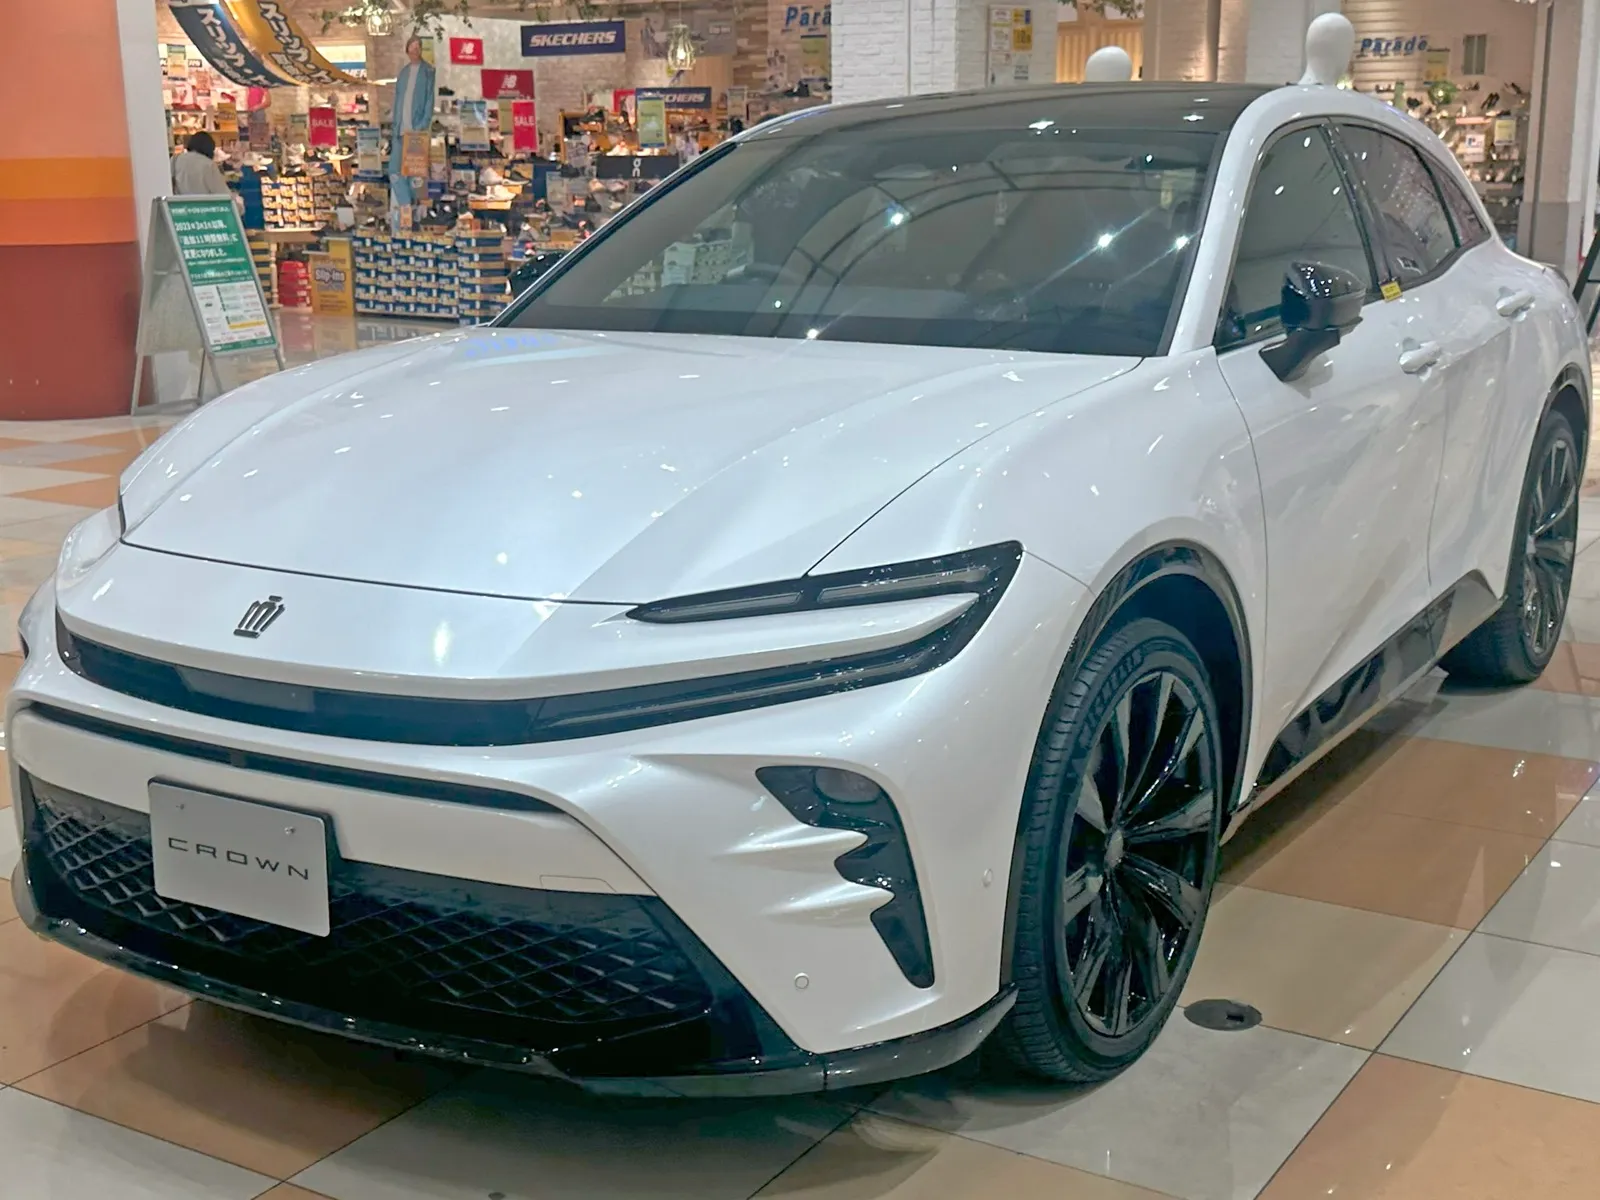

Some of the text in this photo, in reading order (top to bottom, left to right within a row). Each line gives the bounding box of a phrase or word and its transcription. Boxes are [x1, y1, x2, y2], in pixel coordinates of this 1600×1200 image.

[529, 30, 616, 48] SKECHERS
[514, 116, 535, 126] SALE
[167, 836, 309, 880] CROWN
